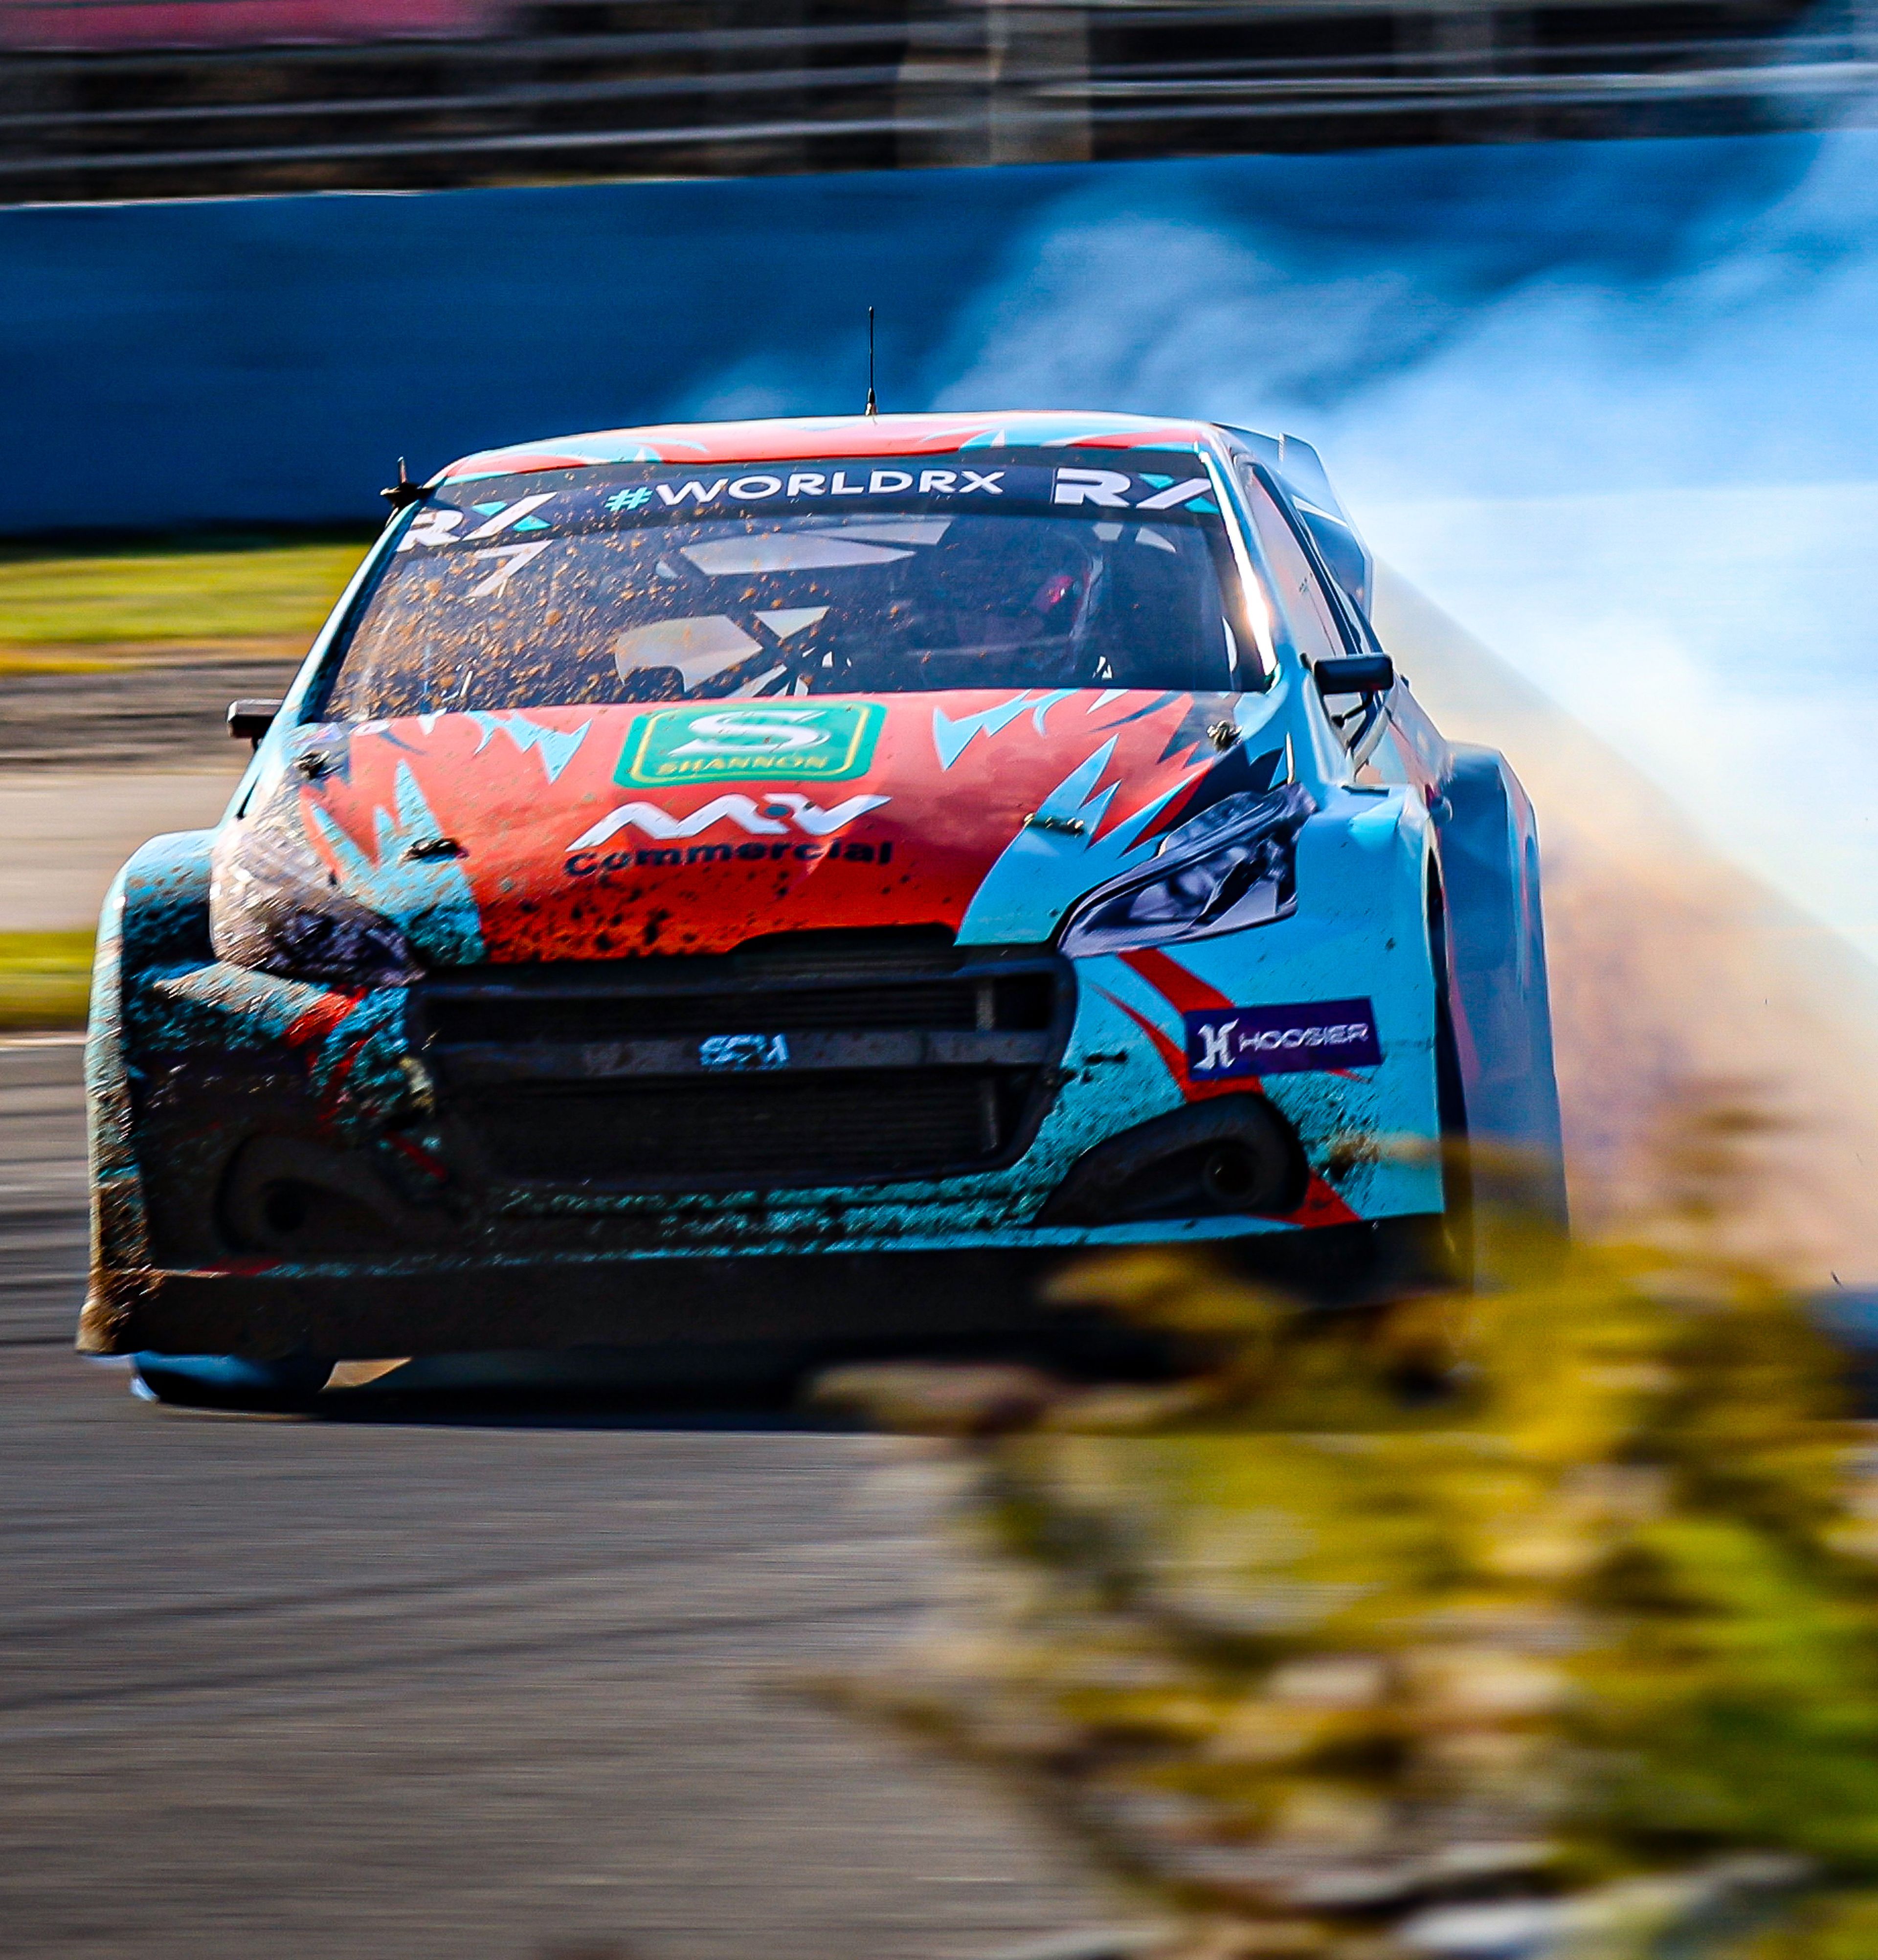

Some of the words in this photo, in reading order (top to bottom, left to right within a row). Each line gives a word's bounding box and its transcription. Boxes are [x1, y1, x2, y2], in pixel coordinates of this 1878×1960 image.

[604, 469, 1005, 513] #WORLDRX
[656, 757, 829, 775] SHANNON
[563, 839, 894, 878] Commercial
[1239, 1022, 1369, 1053] HOOSIER
